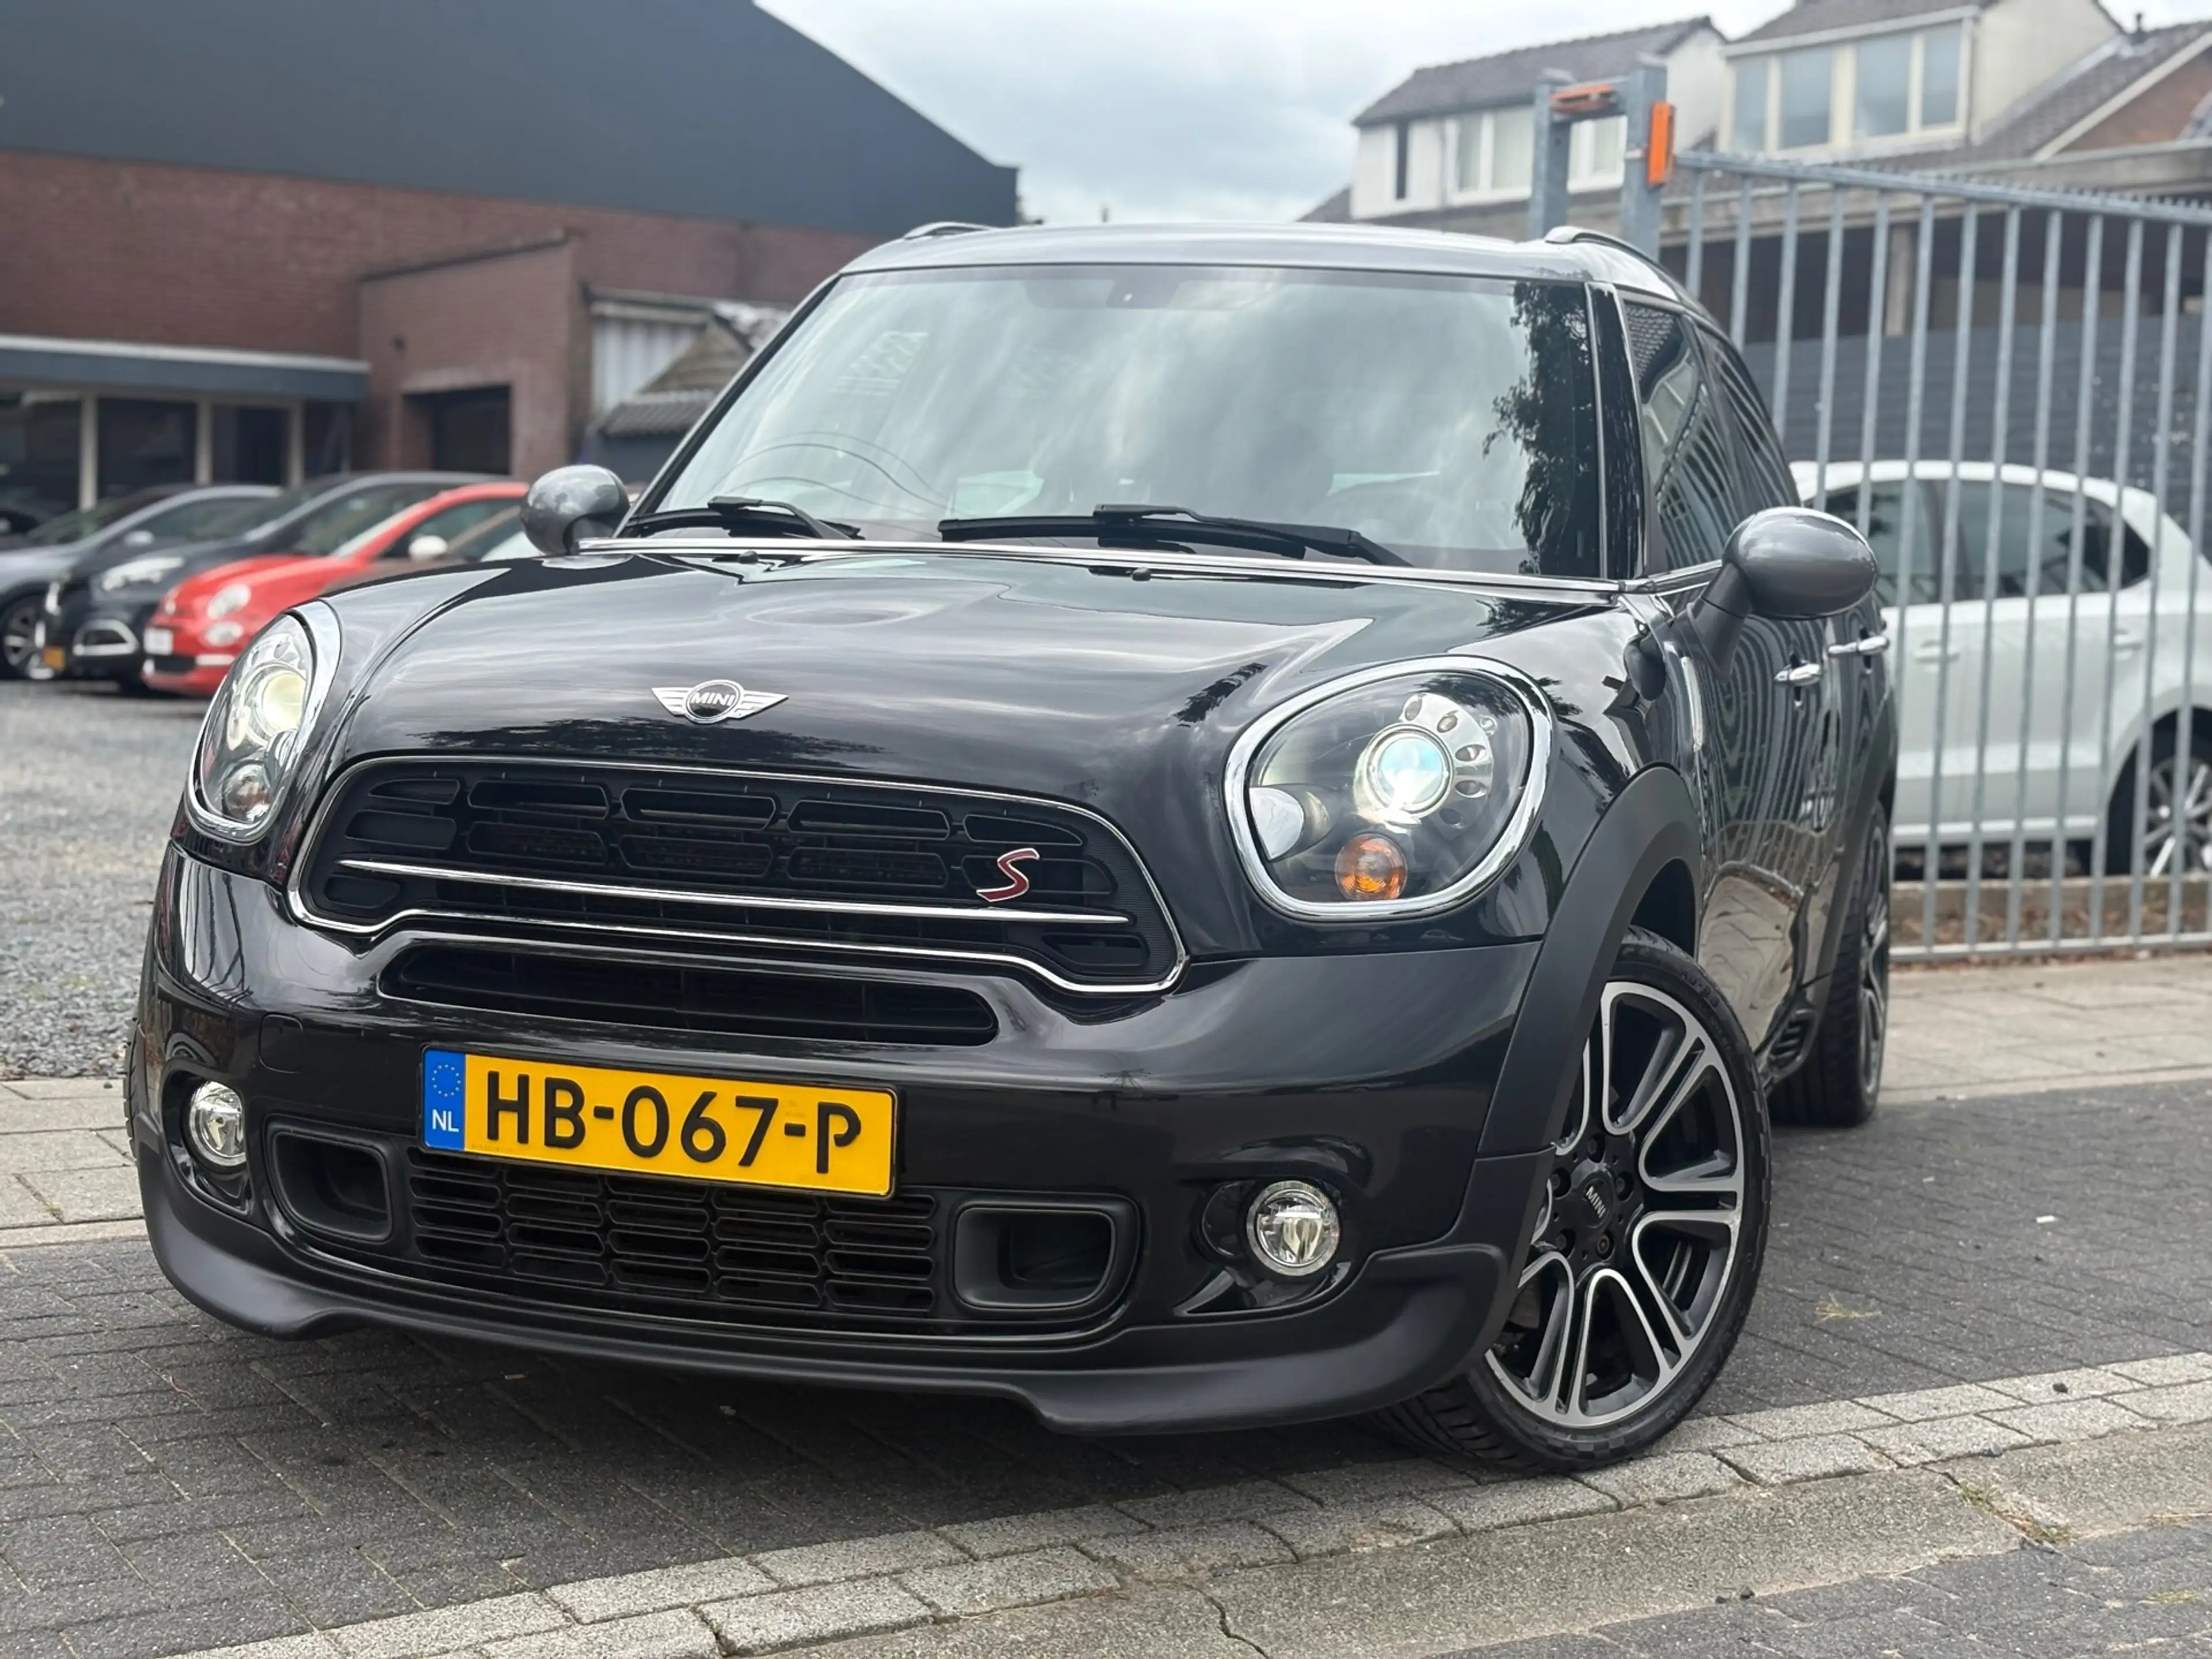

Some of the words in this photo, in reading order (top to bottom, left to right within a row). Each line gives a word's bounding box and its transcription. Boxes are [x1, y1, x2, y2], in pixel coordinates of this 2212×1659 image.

[691, 692, 736, 706] MINI
[976, 847, 1040, 902] S
[432, 1108, 460, 1132] NL
[486, 1070, 862, 1174] HB-067-P
[1585, 1185, 1606, 1218] MINI
